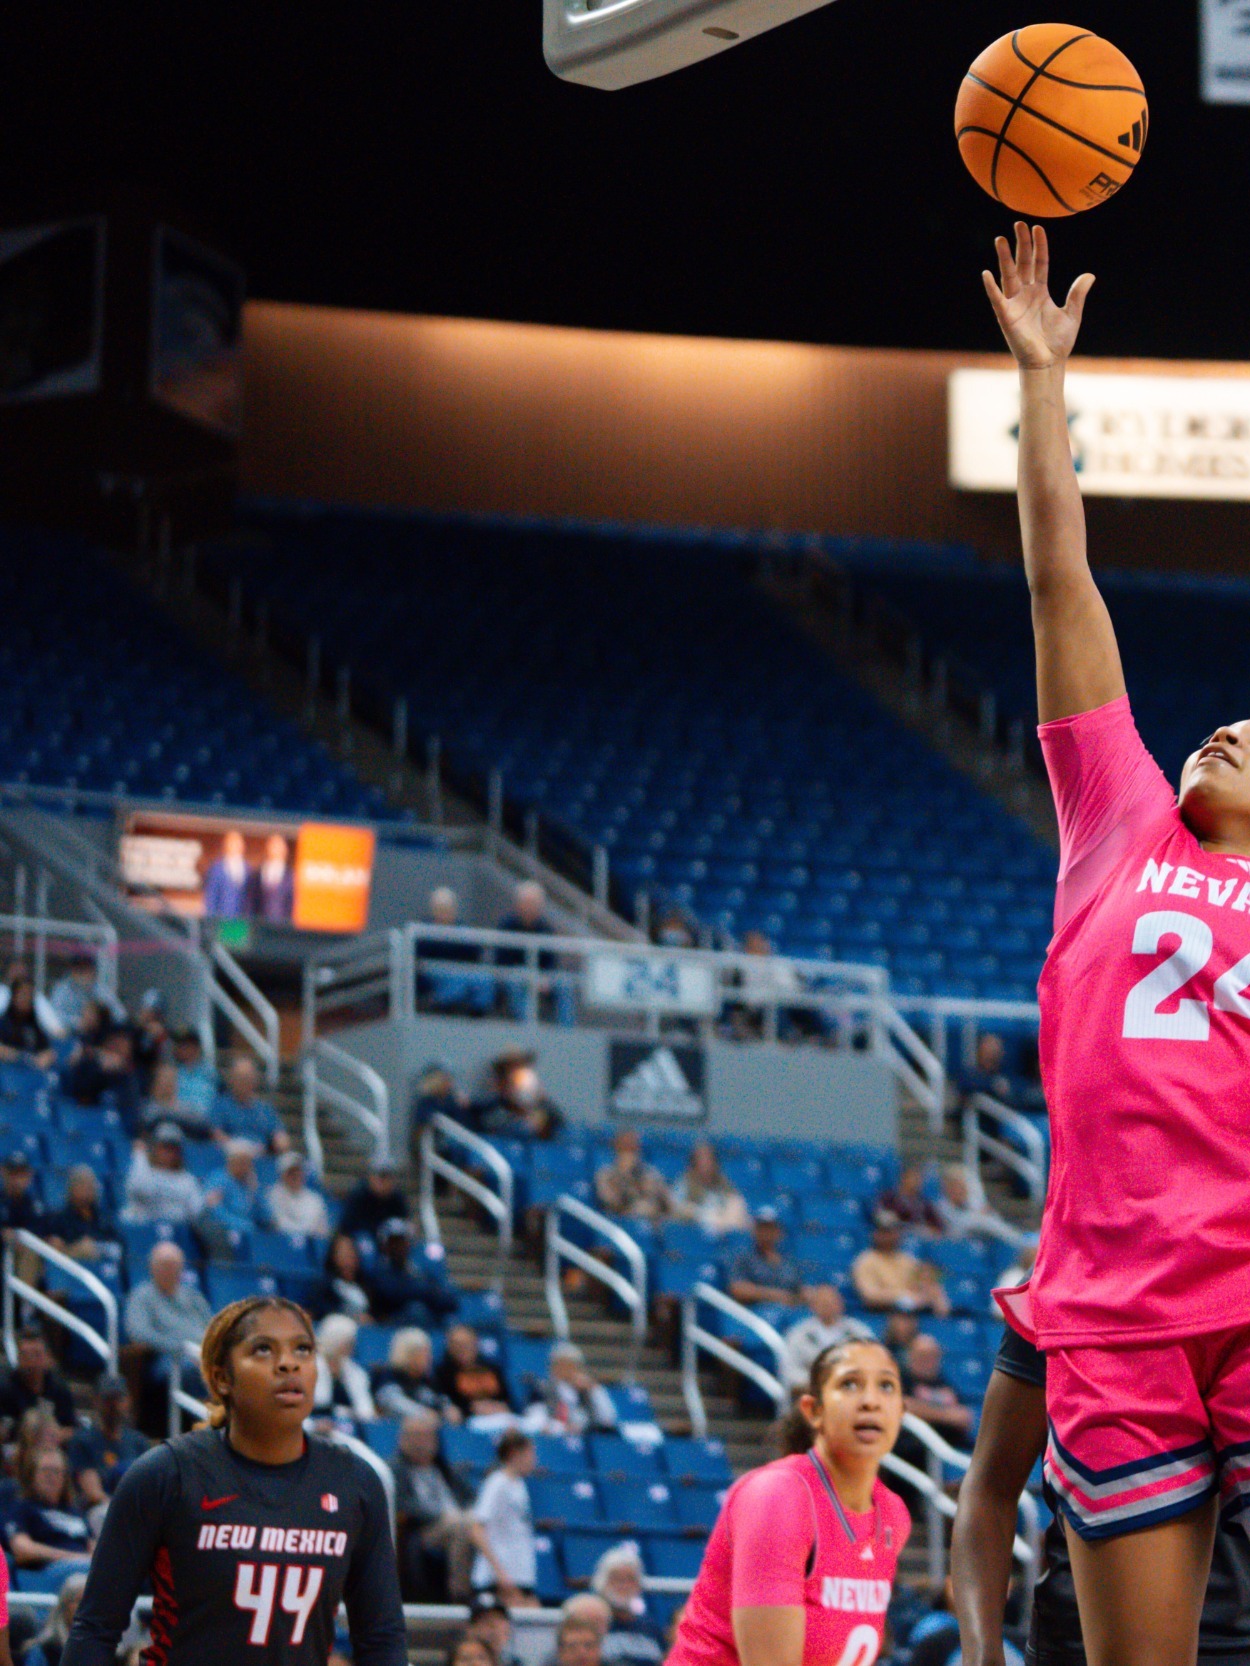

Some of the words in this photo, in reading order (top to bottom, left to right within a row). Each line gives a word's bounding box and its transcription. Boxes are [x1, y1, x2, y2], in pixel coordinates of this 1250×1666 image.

[622, 956, 680, 997] 24
[197, 1524, 257, 1550] NEW
[259, 1526, 348, 1557] MEXICO
[234, 1561, 325, 1646] 44
